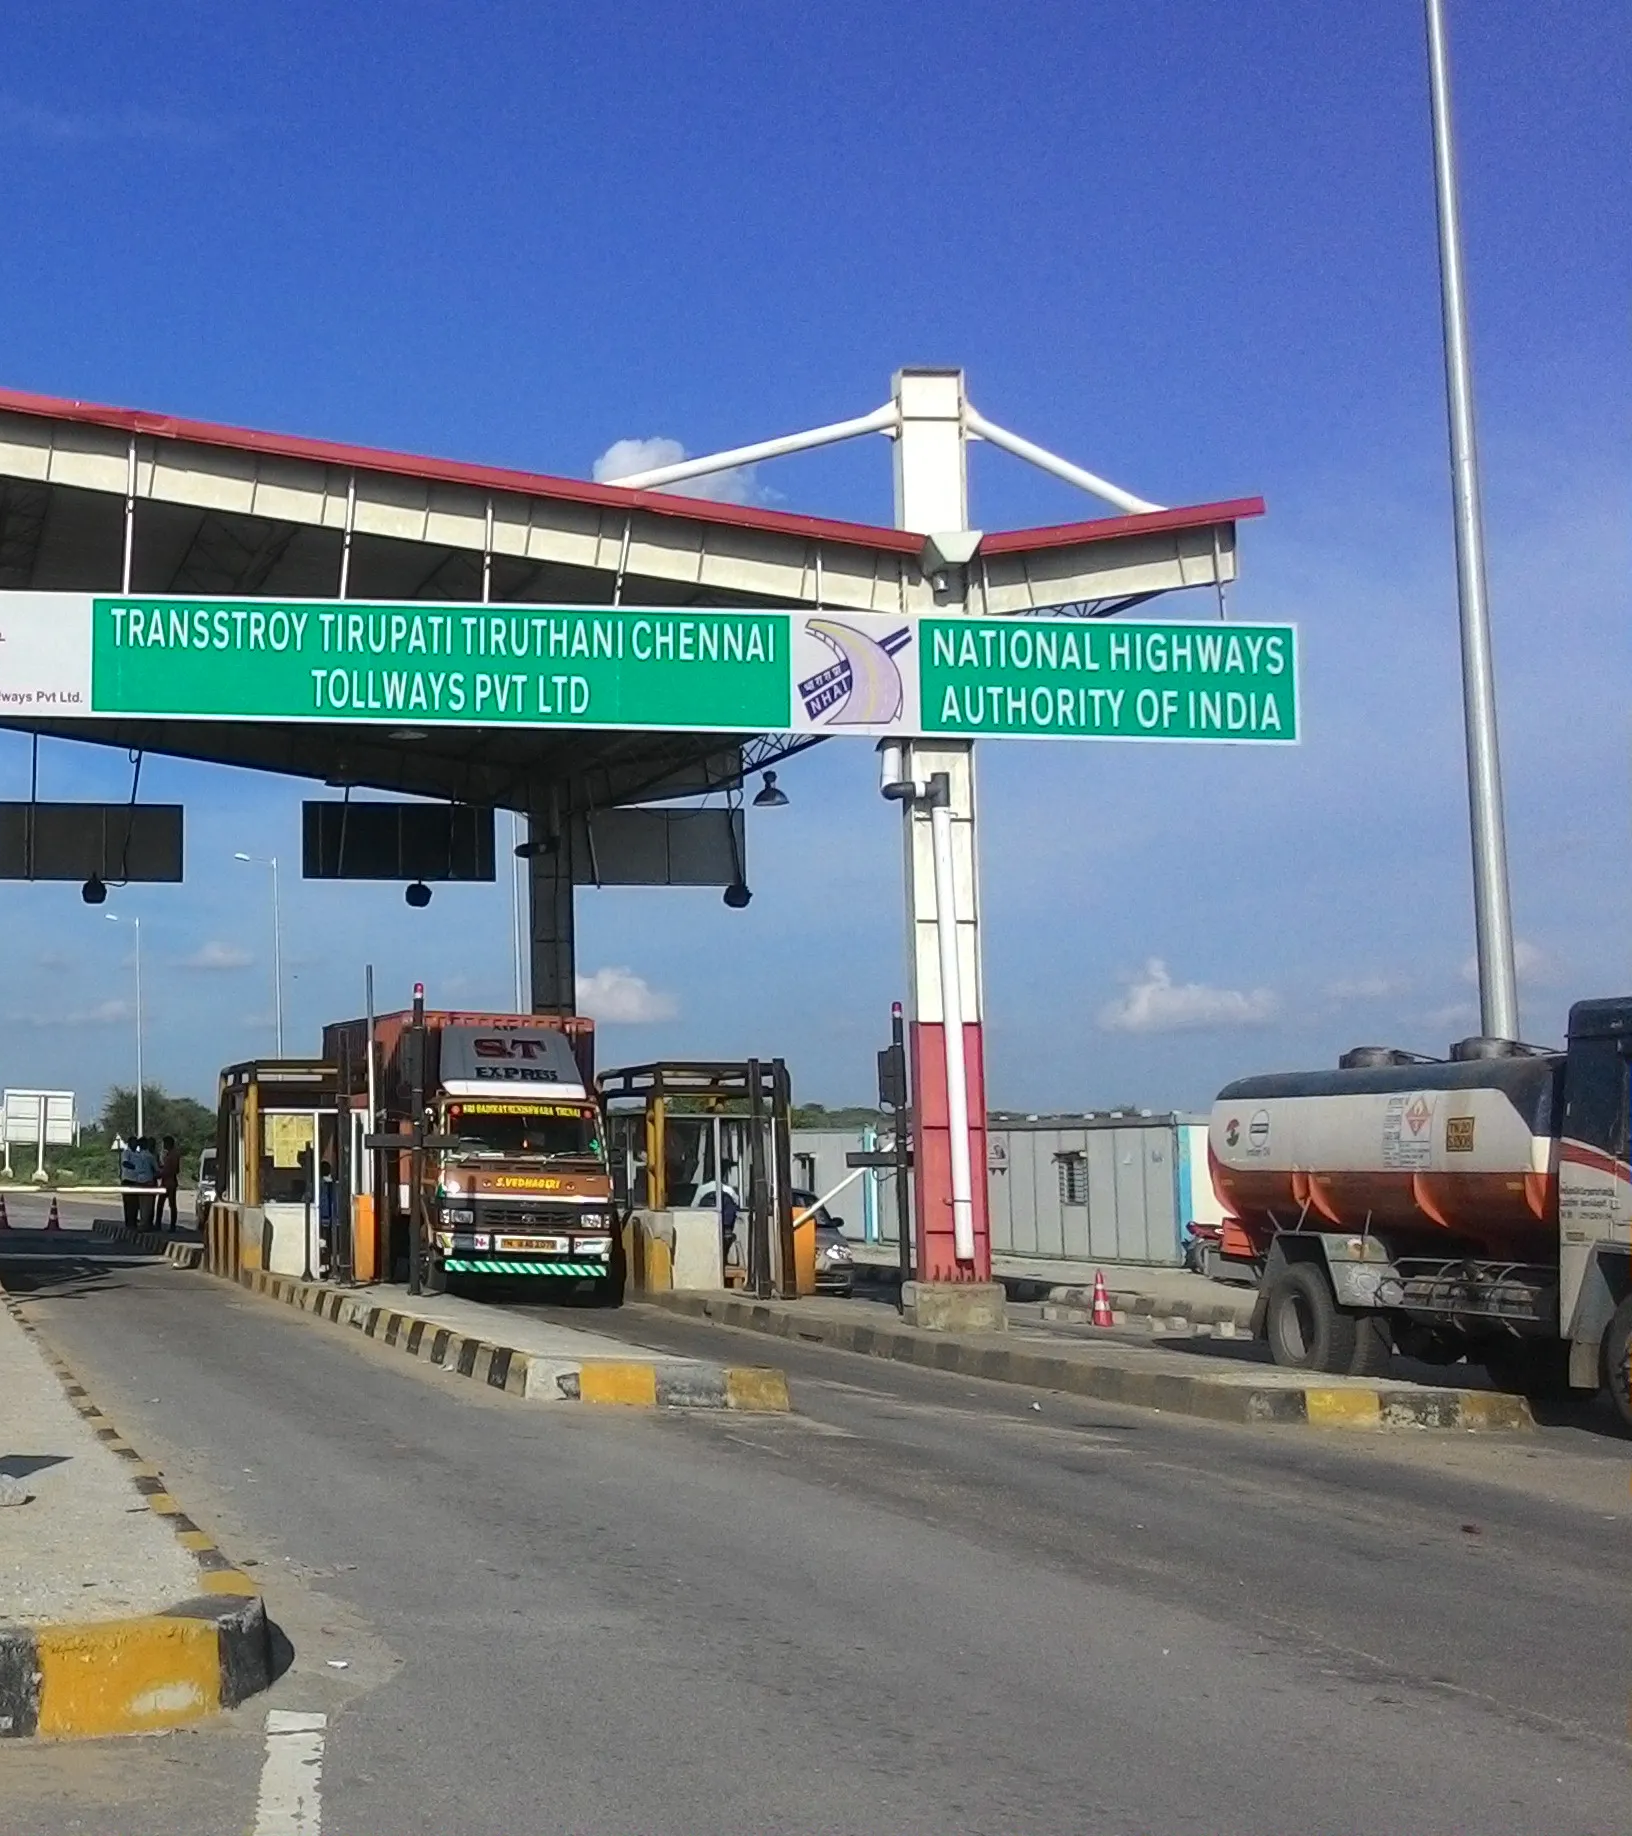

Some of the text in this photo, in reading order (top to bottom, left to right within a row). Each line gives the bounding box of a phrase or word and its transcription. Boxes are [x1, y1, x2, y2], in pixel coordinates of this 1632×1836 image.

[111, 608, 776, 663] TRANSSTROY TIRUPATI TIRUTHANI CHENNAI
[932, 628, 1285, 675] NATIONAL HIGHWAYS
[36, 691, 56, 702] Pvt
[60, 692, 83, 703] Ltd.
[311, 668, 590, 715] TOLLWAYS PVT LTD
[810, 679, 848, 714] NHAI
[941, 685, 1282, 731] AUTHORITY OF INDIA
[475, 1066, 558, 1081] EXPRESS
